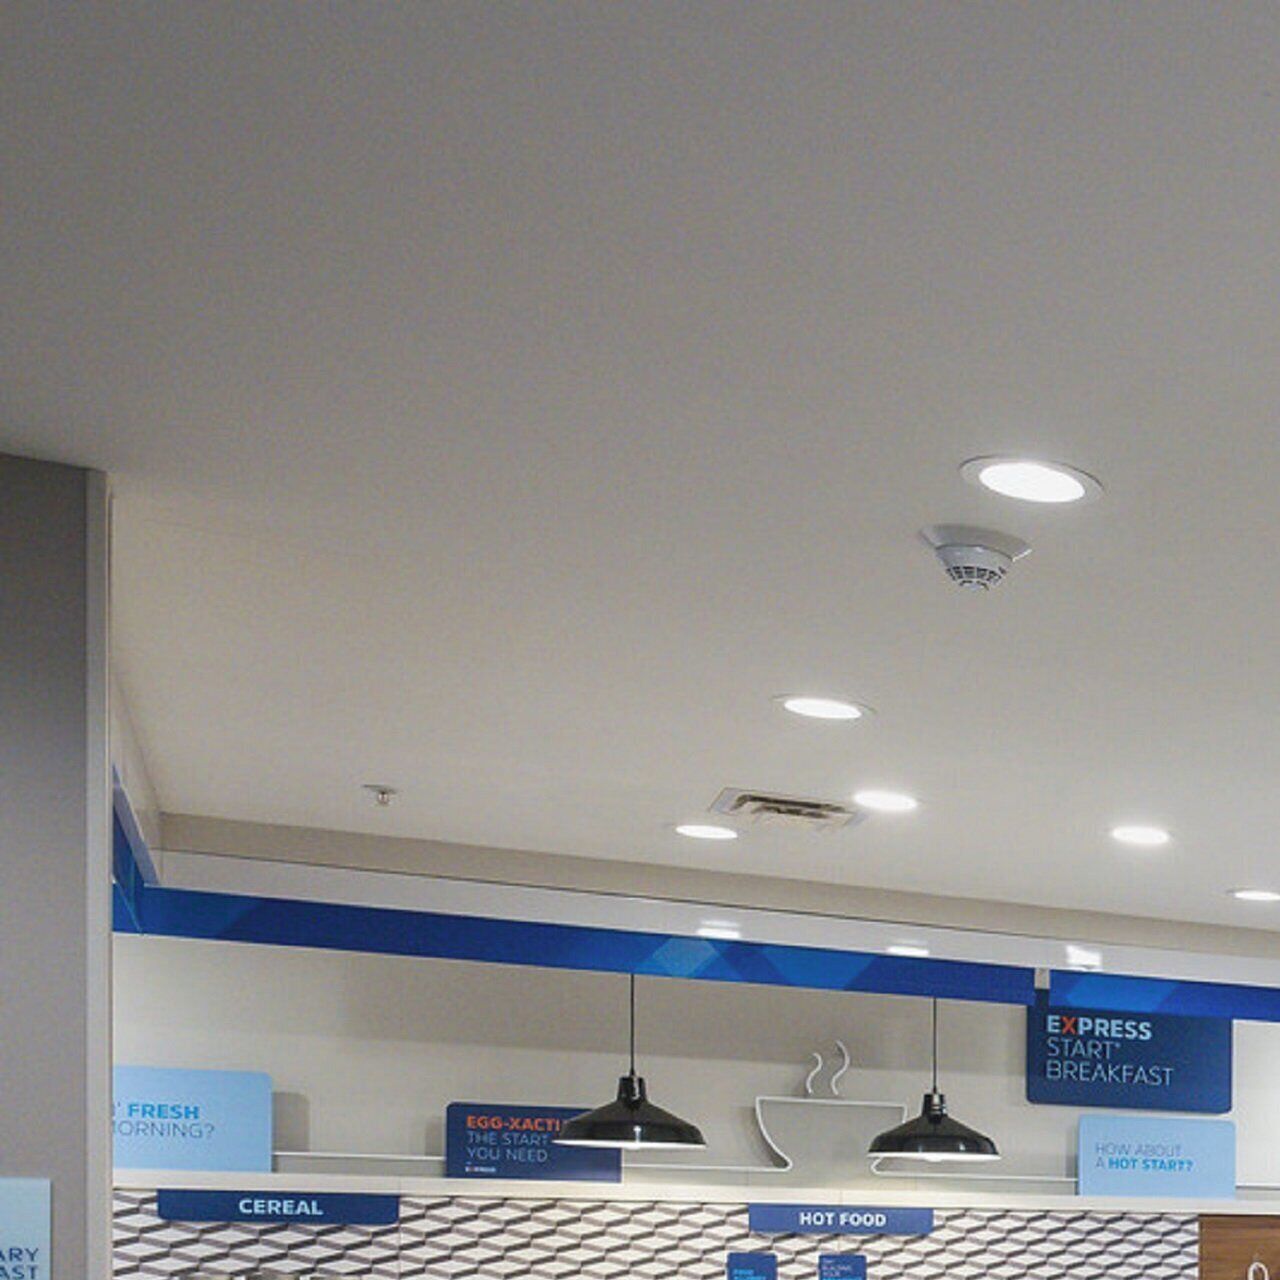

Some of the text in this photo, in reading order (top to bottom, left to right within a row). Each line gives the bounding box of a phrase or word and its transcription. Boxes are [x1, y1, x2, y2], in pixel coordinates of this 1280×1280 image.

[1045, 1014, 1153, 1041] EXPRESS
[1045, 1059, 1175, 1087] BREAKFAST
[127, 1103, 200, 1120] FRESH
[112, 1120, 216, 1139] ORNING?
[466, 1131, 550, 1147] THE START
[465, 1146, 549, 1163] YOU NEED
[1095, 1142, 1183, 1158] HOW ABOUT
[1095, 1157, 1105, 1168] A
[1108, 1157, 1139, 1170] HOT
[238, 1198, 324, 1216] CEREAL
[799, 1211, 887, 1228] HOT FOOD
